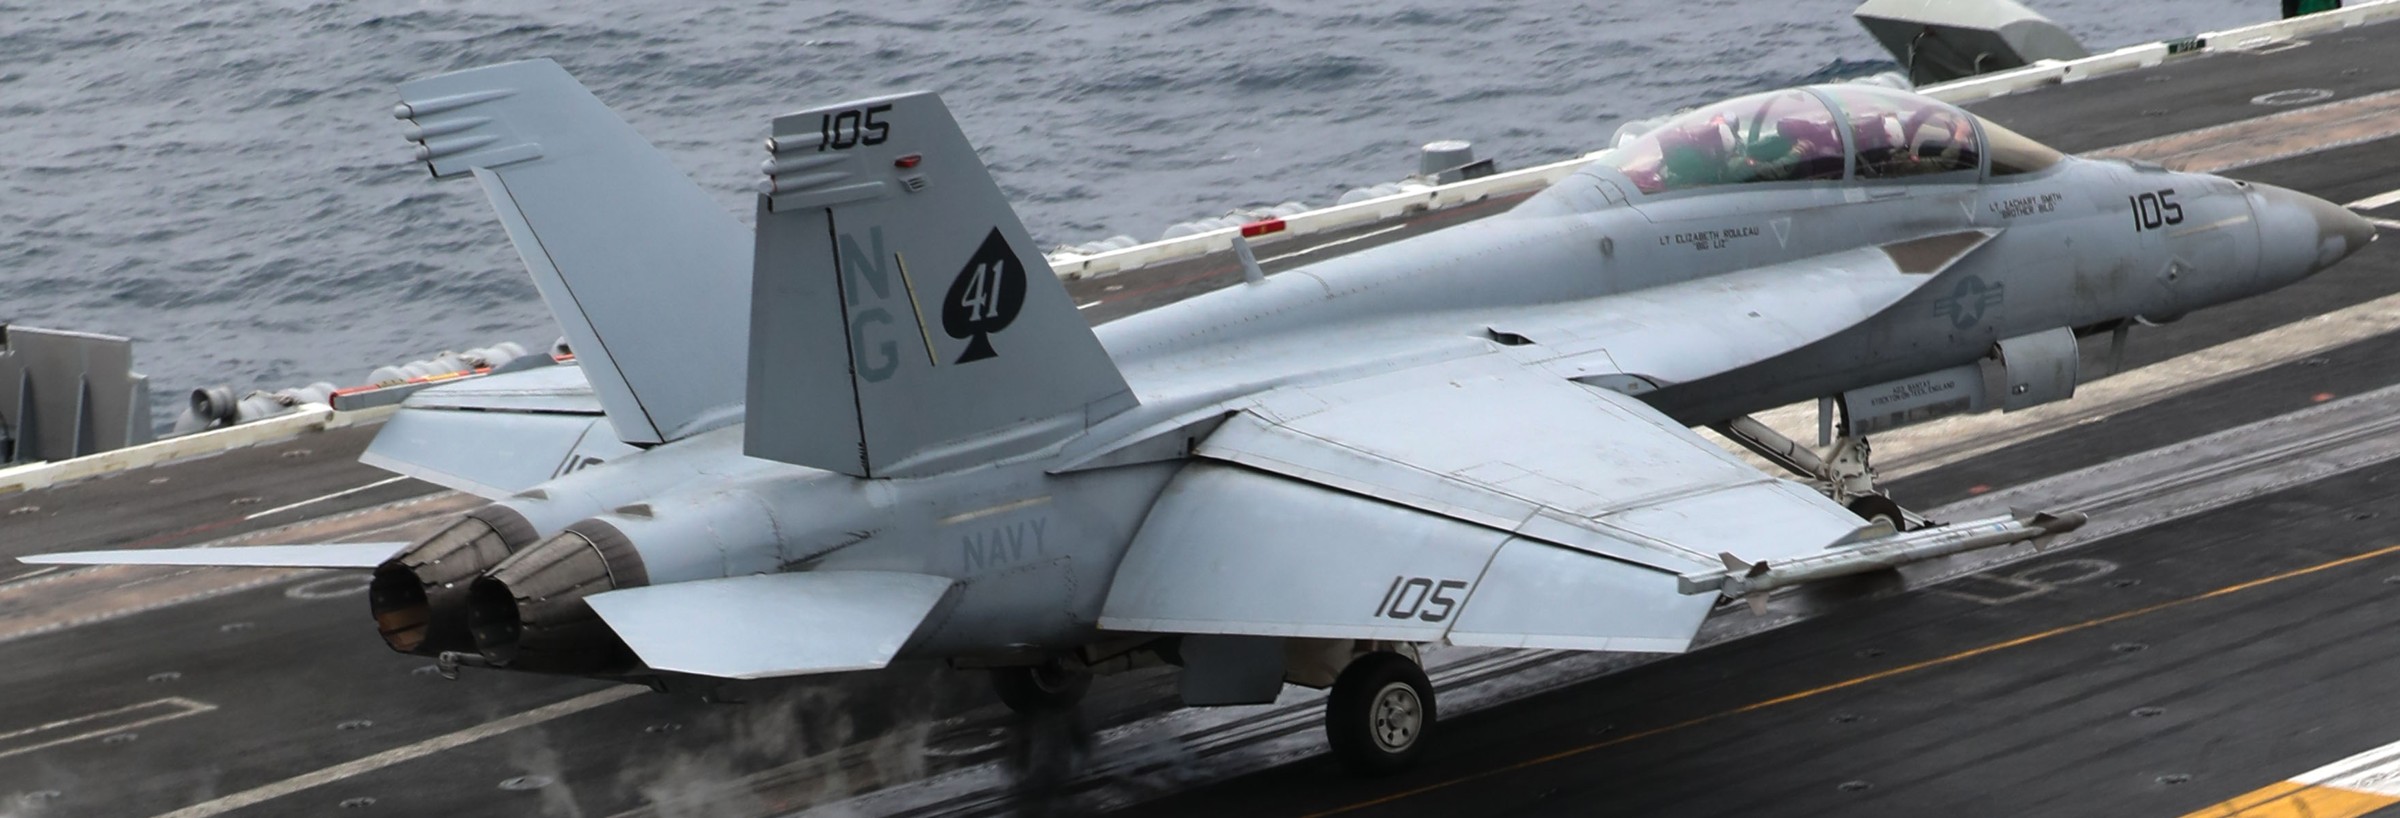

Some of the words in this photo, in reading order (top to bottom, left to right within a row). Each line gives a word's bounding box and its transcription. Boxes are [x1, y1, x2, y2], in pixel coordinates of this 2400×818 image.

[817, 103, 894, 152] 105
[1988, 201, 1999, 213] LT
[2003, 196, 2037, 209] ZACHARY
[2040, 192, 2063, 204] SMITH
[2129, 188, 2184, 232] 105
[1659, 235, 1670, 246] LT
[1675, 230, 1719, 244] ELIZABETH
[1723, 226, 1760, 239] ROULEAU
[959, 258, 1005, 322] 41
[1928, 381, 1955, 393] ENGLAND
[961, 516, 1047, 572] NAVY
[1374, 574, 1468, 622] 105
